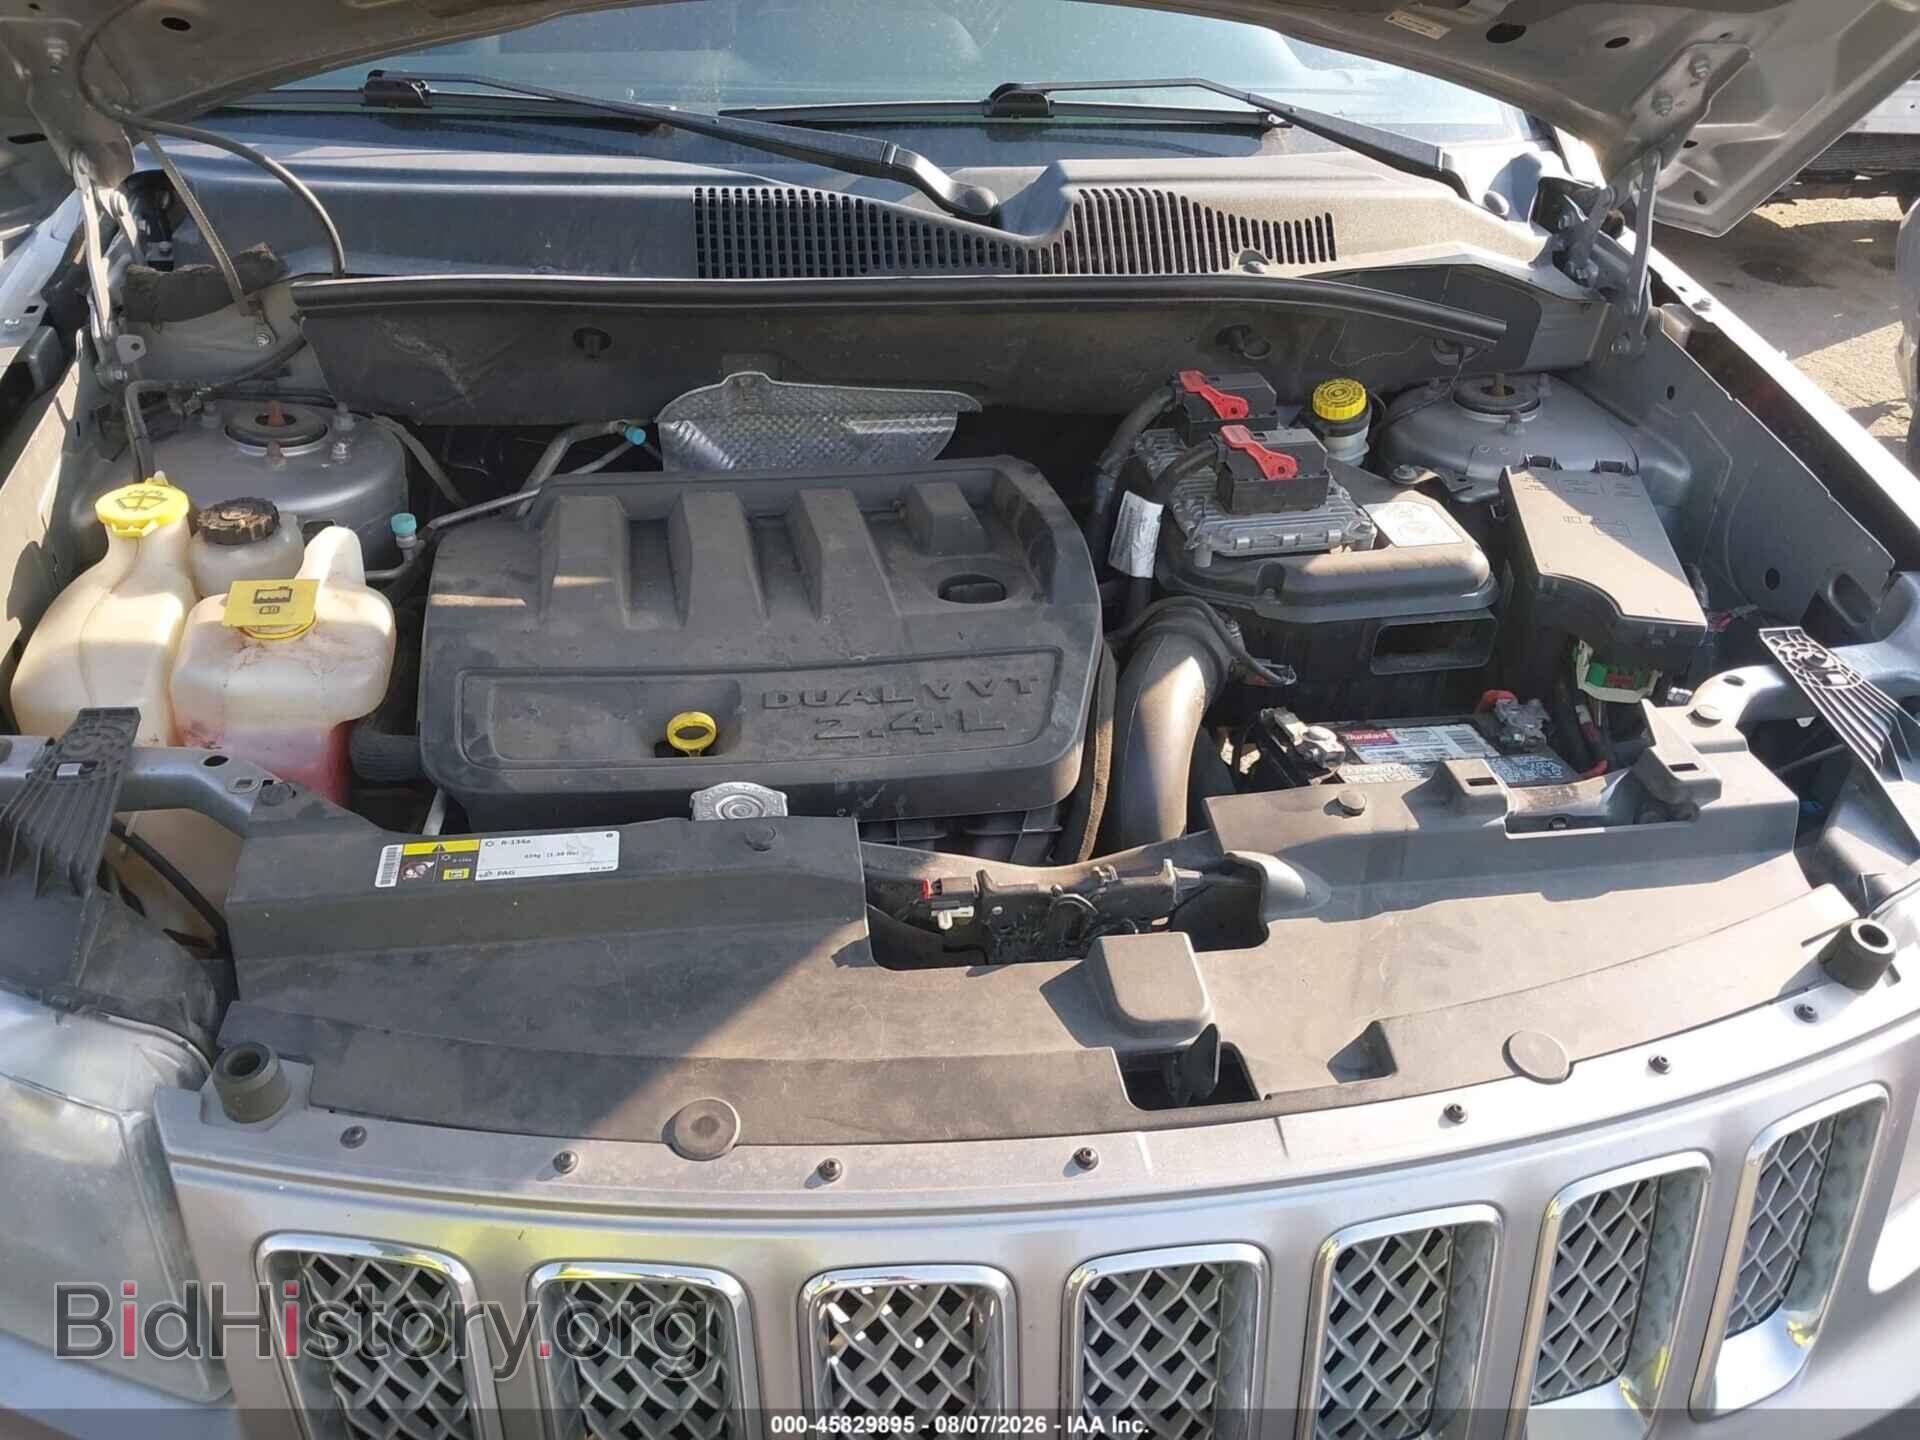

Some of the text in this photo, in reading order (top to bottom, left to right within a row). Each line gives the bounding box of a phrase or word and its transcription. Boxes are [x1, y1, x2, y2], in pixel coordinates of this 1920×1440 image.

[762, 676, 1039, 709] DUAL VVT
[814, 709, 1006, 741] 2.4L
